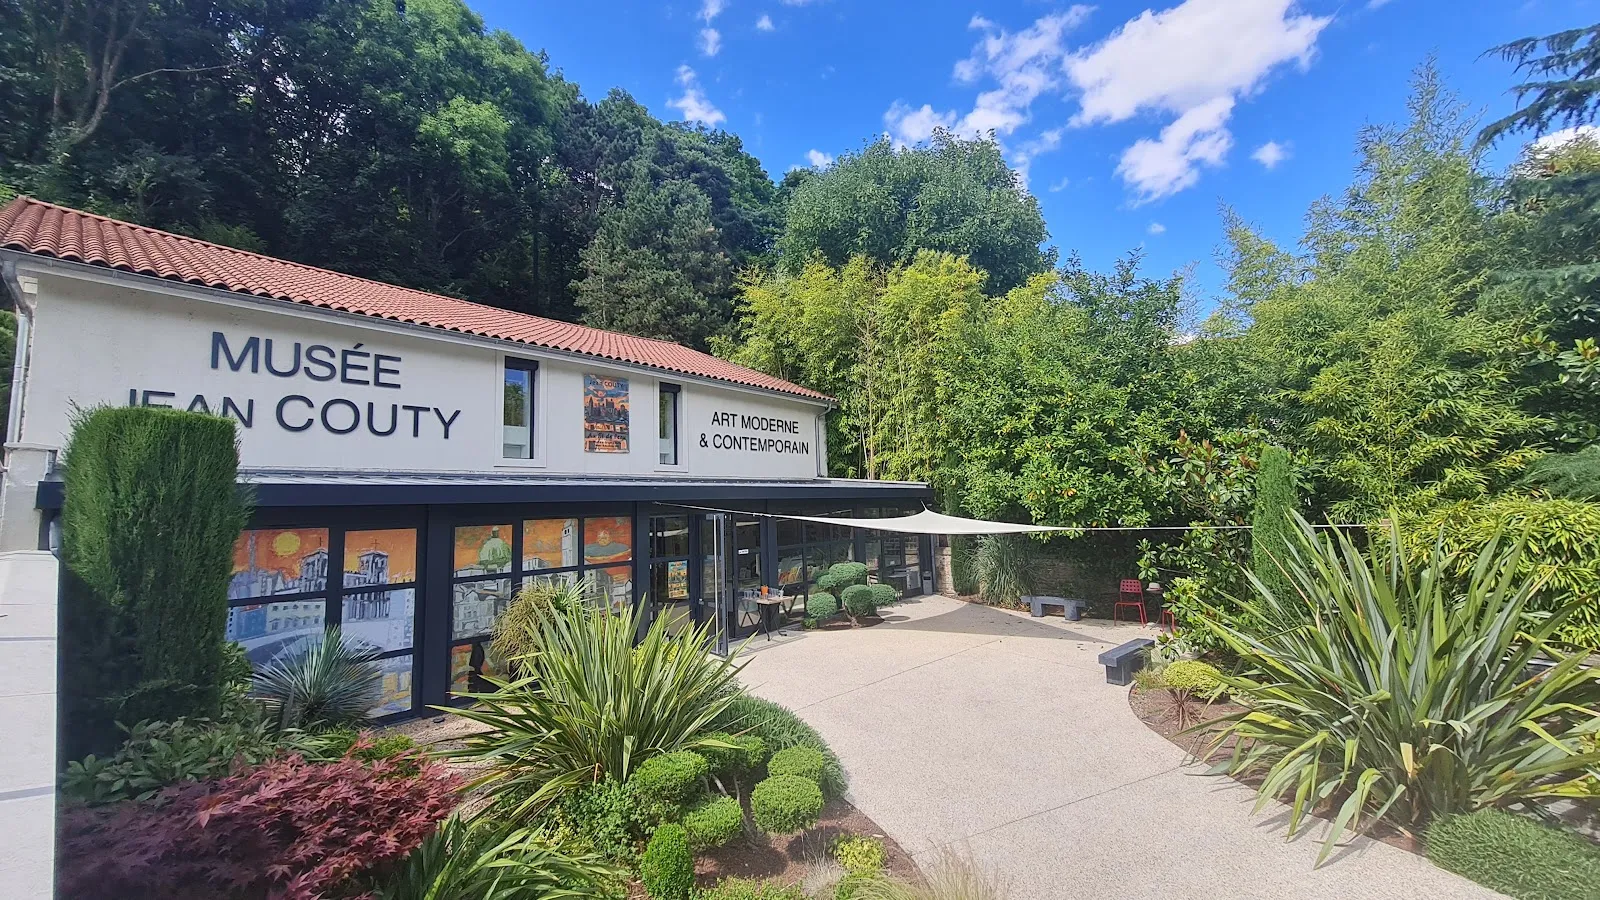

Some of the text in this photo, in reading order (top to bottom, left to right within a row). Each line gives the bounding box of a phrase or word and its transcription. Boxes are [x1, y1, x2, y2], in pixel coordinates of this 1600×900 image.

[211, 331, 402, 389] MUSÉE
[276, 394, 461, 439] COUTY
[711, 411, 799, 434] ART MODERNE
[699, 432, 809, 455] & CONTEMPORAIN
